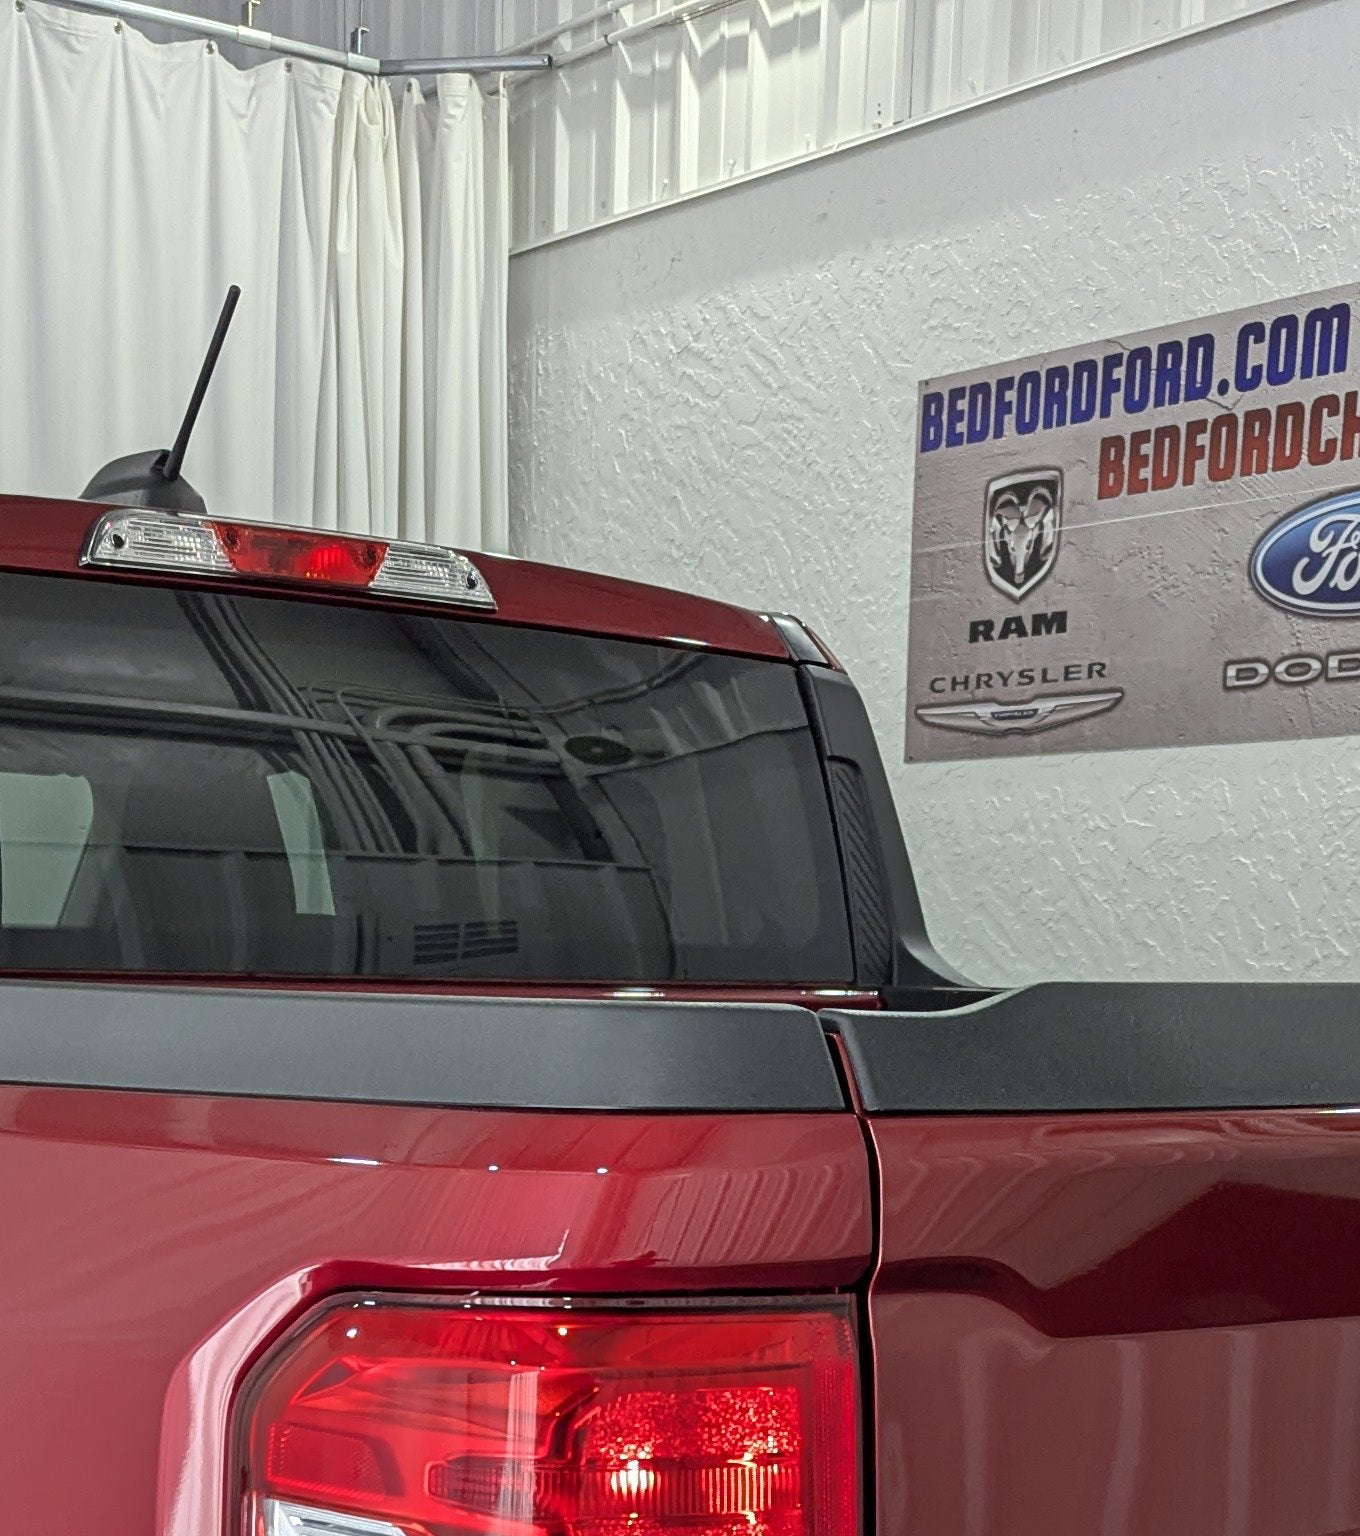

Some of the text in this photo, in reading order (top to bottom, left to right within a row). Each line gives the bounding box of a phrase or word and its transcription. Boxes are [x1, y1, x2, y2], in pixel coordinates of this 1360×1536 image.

[921, 303, 1351, 453] BEDFORDFORD.COM
[968, 611, 1068, 644] RAM
[929, 661, 1107, 694] CHRYSLER
